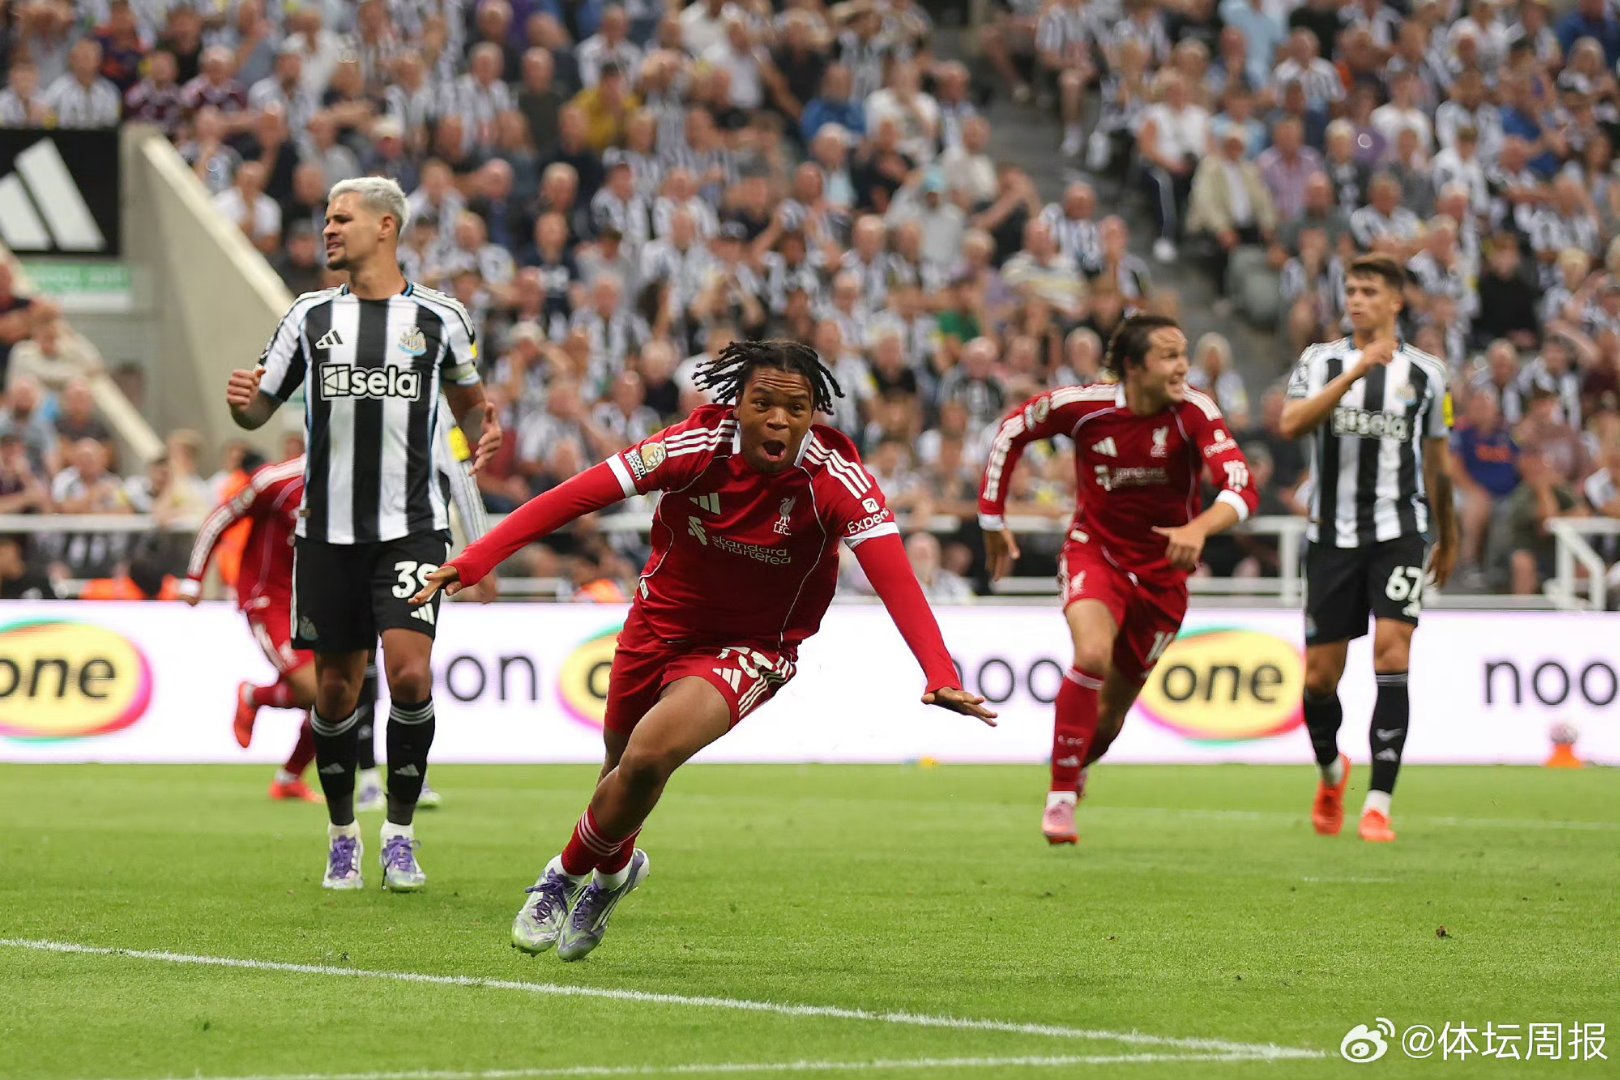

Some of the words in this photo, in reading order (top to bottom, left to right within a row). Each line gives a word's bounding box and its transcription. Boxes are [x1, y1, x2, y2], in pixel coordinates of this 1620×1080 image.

[350, 366, 419, 398] sela
[712, 536, 788, 557] standard
[714, 542, 792, 565] chartered
[392, 560, 441, 601] 39
[1385, 565, 1423, 601] 67
[445, 656, 537, 701] on
[1163, 664, 1283, 703] one
